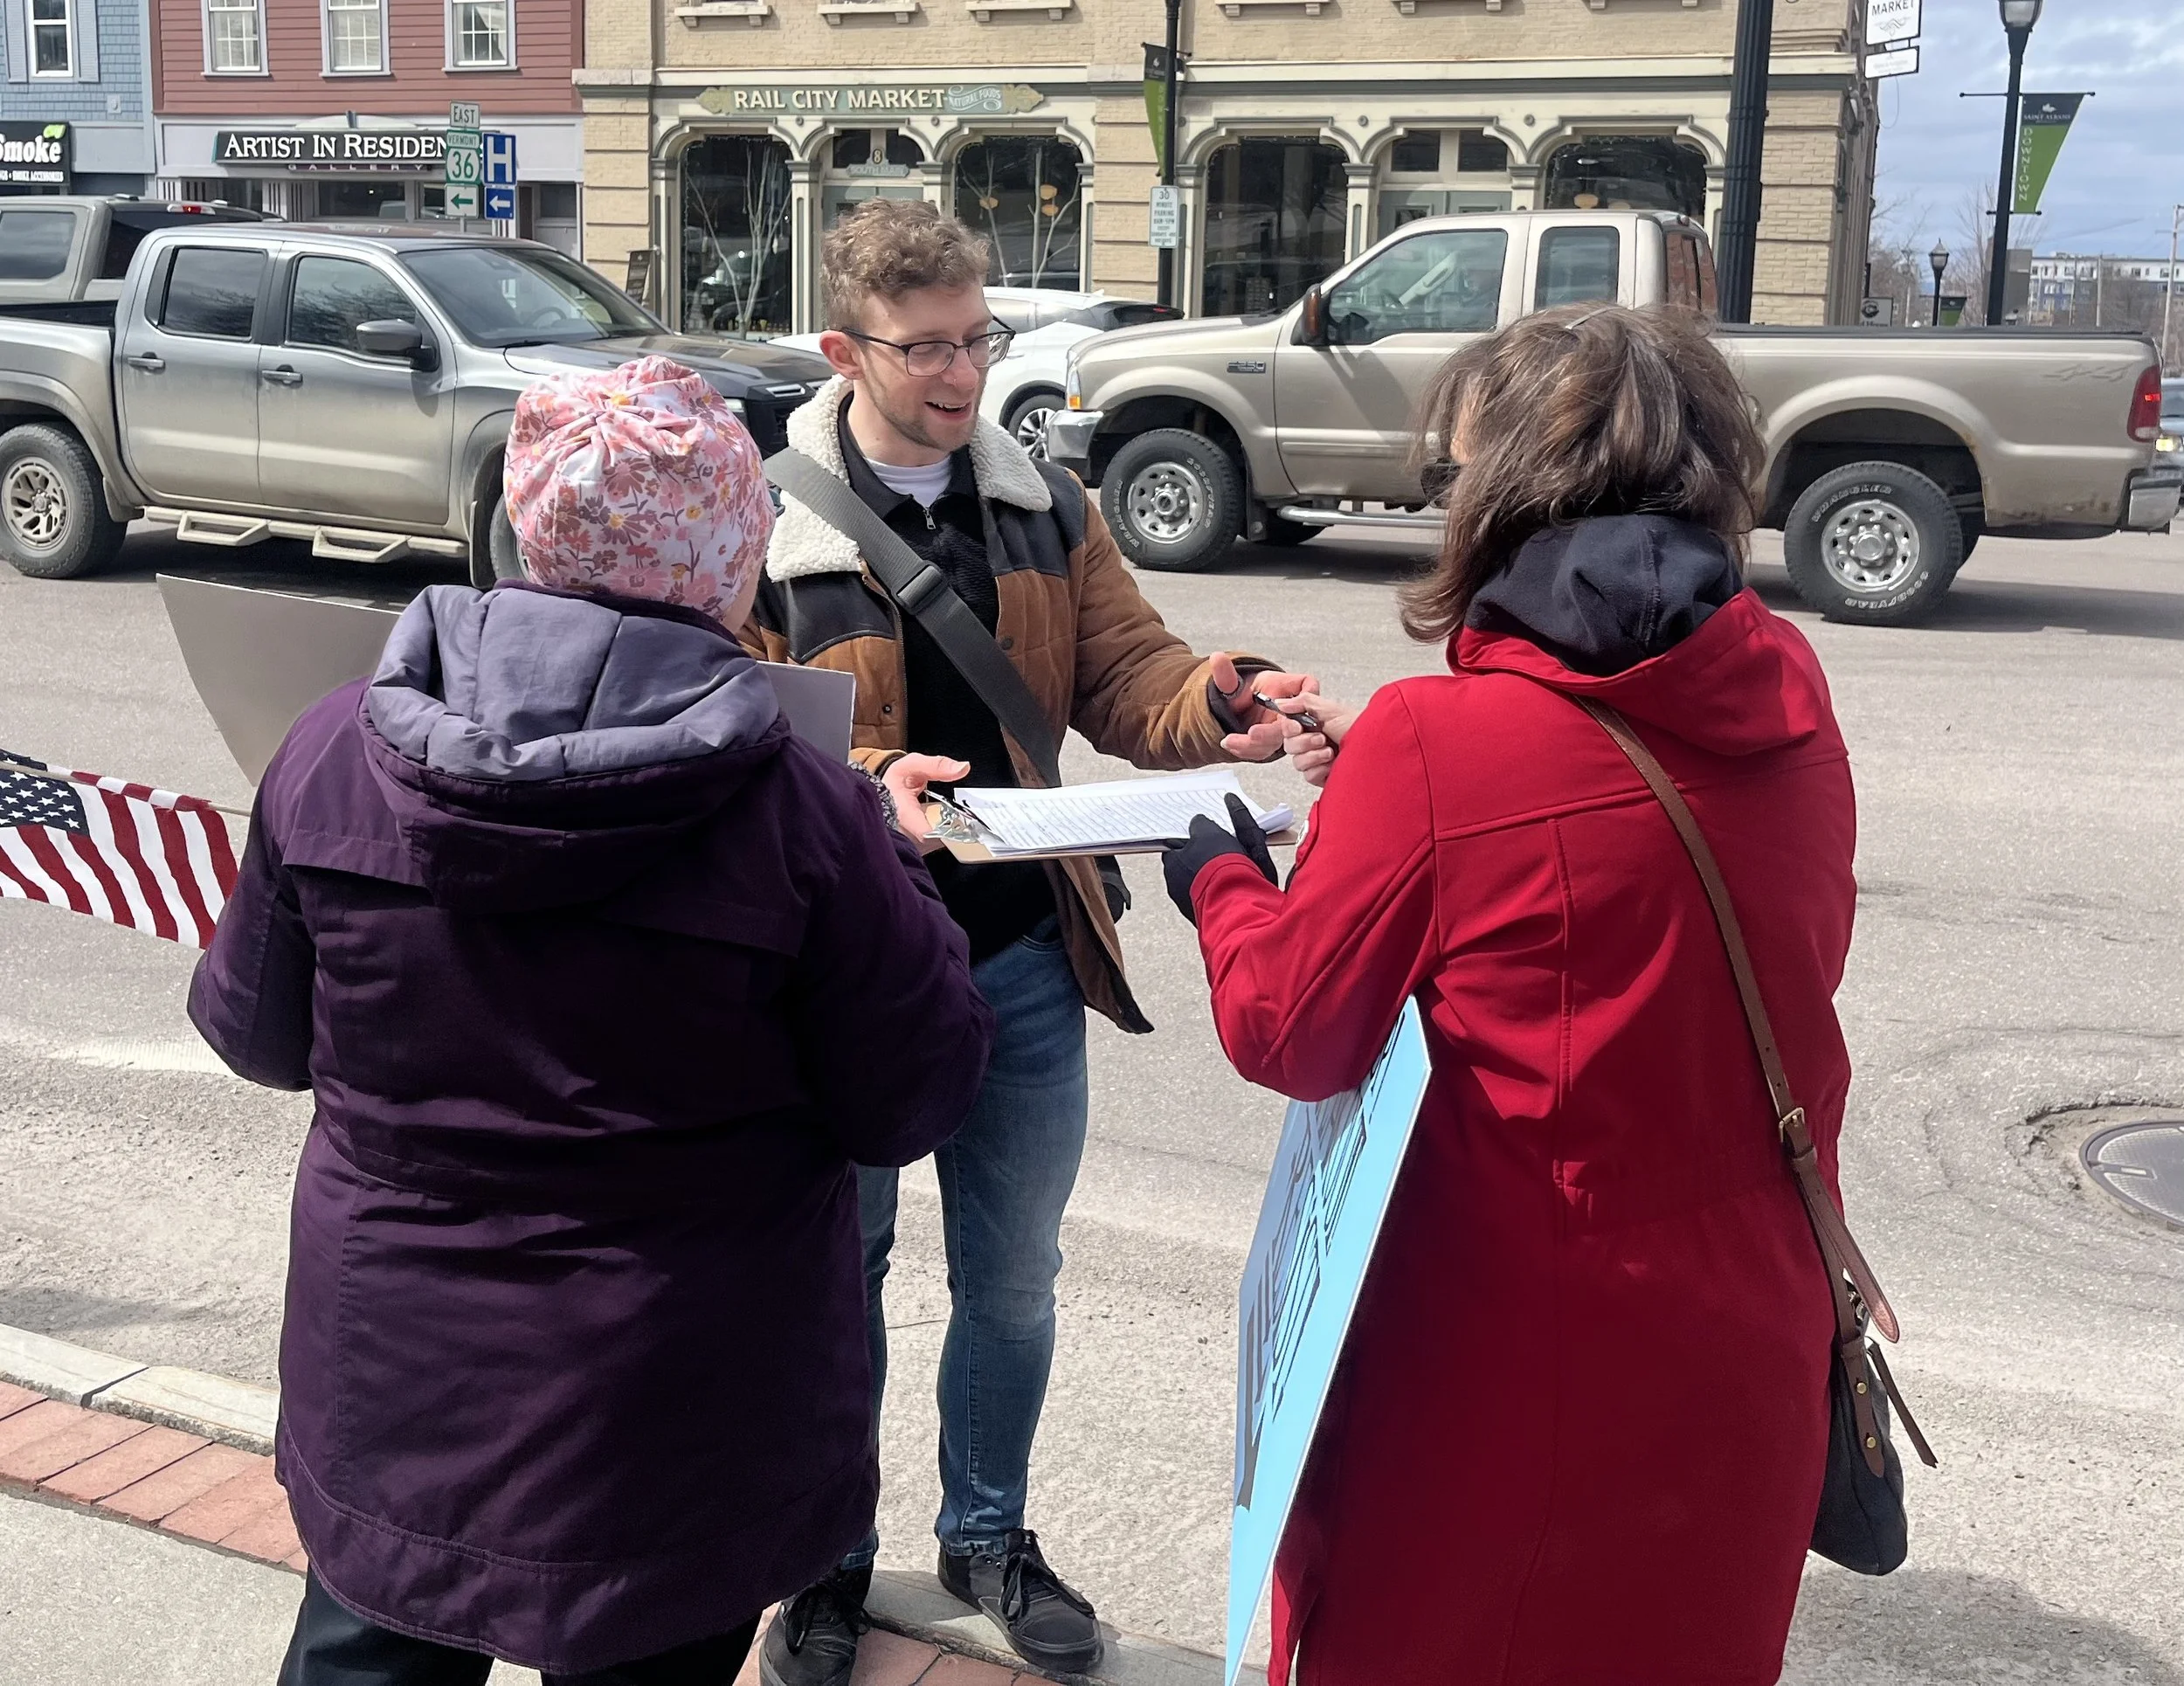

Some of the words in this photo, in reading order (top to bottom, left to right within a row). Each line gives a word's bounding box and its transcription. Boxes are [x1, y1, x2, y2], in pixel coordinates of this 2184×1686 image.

[734, 90, 785, 108] RAIL
[791, 90, 838, 108] CITY
[847, 89, 944, 108] MARKET
[949, 91, 979, 107] NATURAL
[978, 87, 1001, 100] FOODS
[453, 106, 476, 124] EAST
[225, 133, 305, 157] ARTIST
[313, 135, 336, 158] IN
[448, 135, 477, 146] VERMONT
[453, 150, 474, 179] 36
[486, 135, 513, 183] H
[873, 149, 882, 164] 8
[2019, 127, 2033, 201] DOWNTOWN
[1158, 190, 1170, 200] 30
